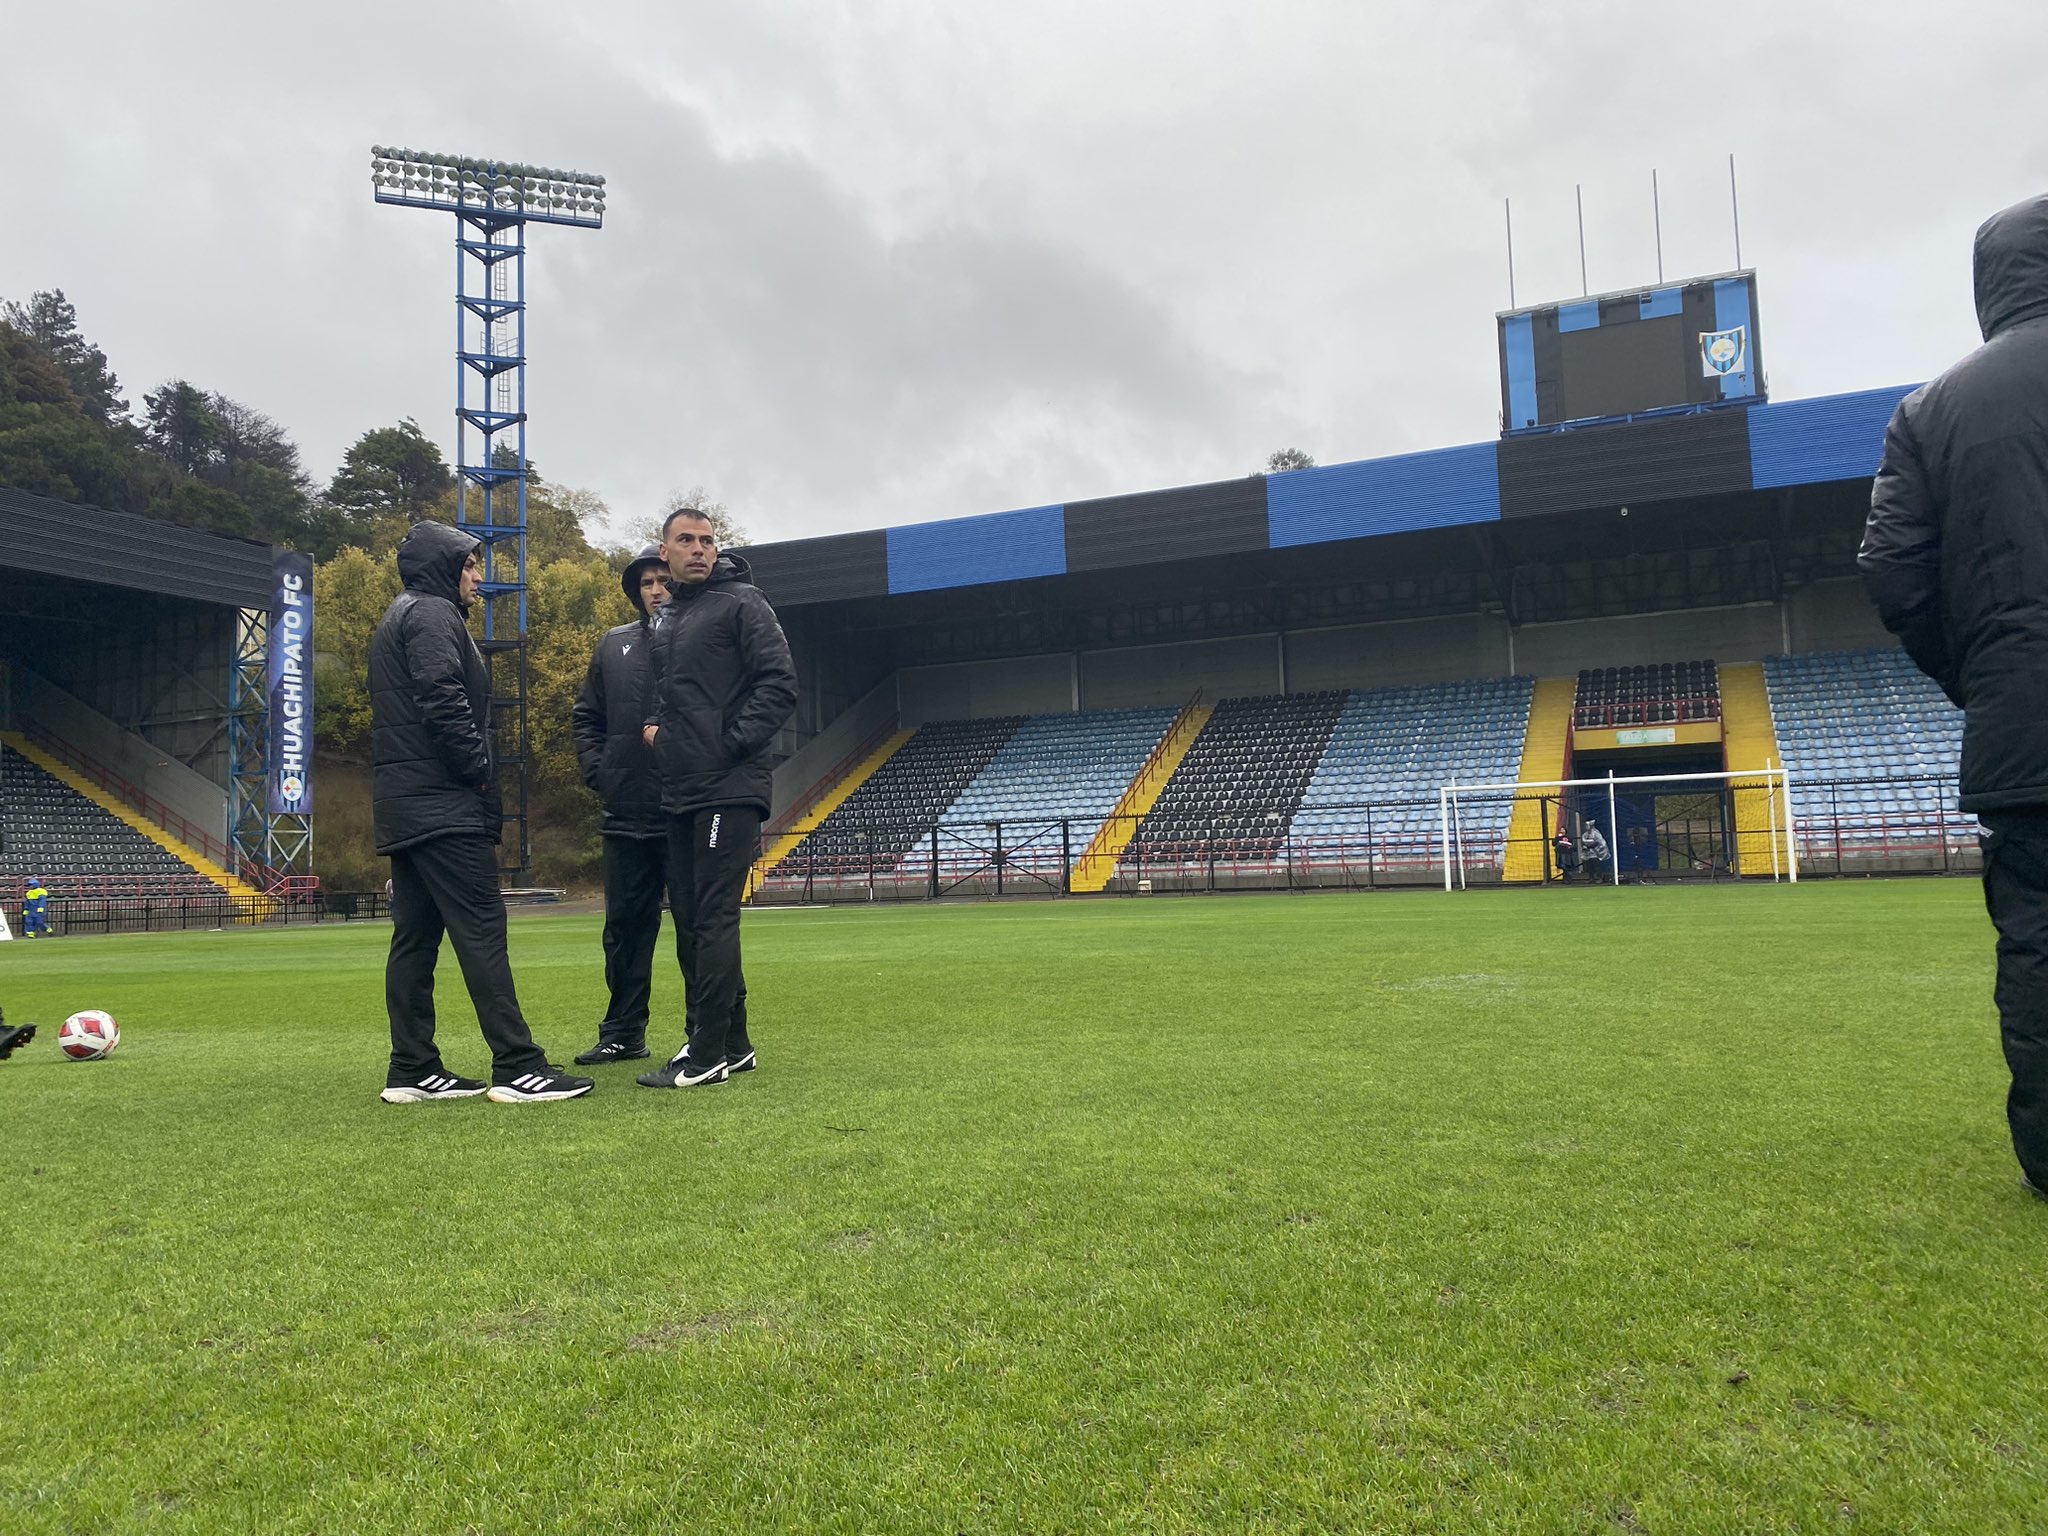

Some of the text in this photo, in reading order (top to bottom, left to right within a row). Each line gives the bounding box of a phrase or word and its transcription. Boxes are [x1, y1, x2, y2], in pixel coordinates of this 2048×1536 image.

[283, 573, 303, 771] HUACHIPATO FC
[709, 813, 721, 848] macron
